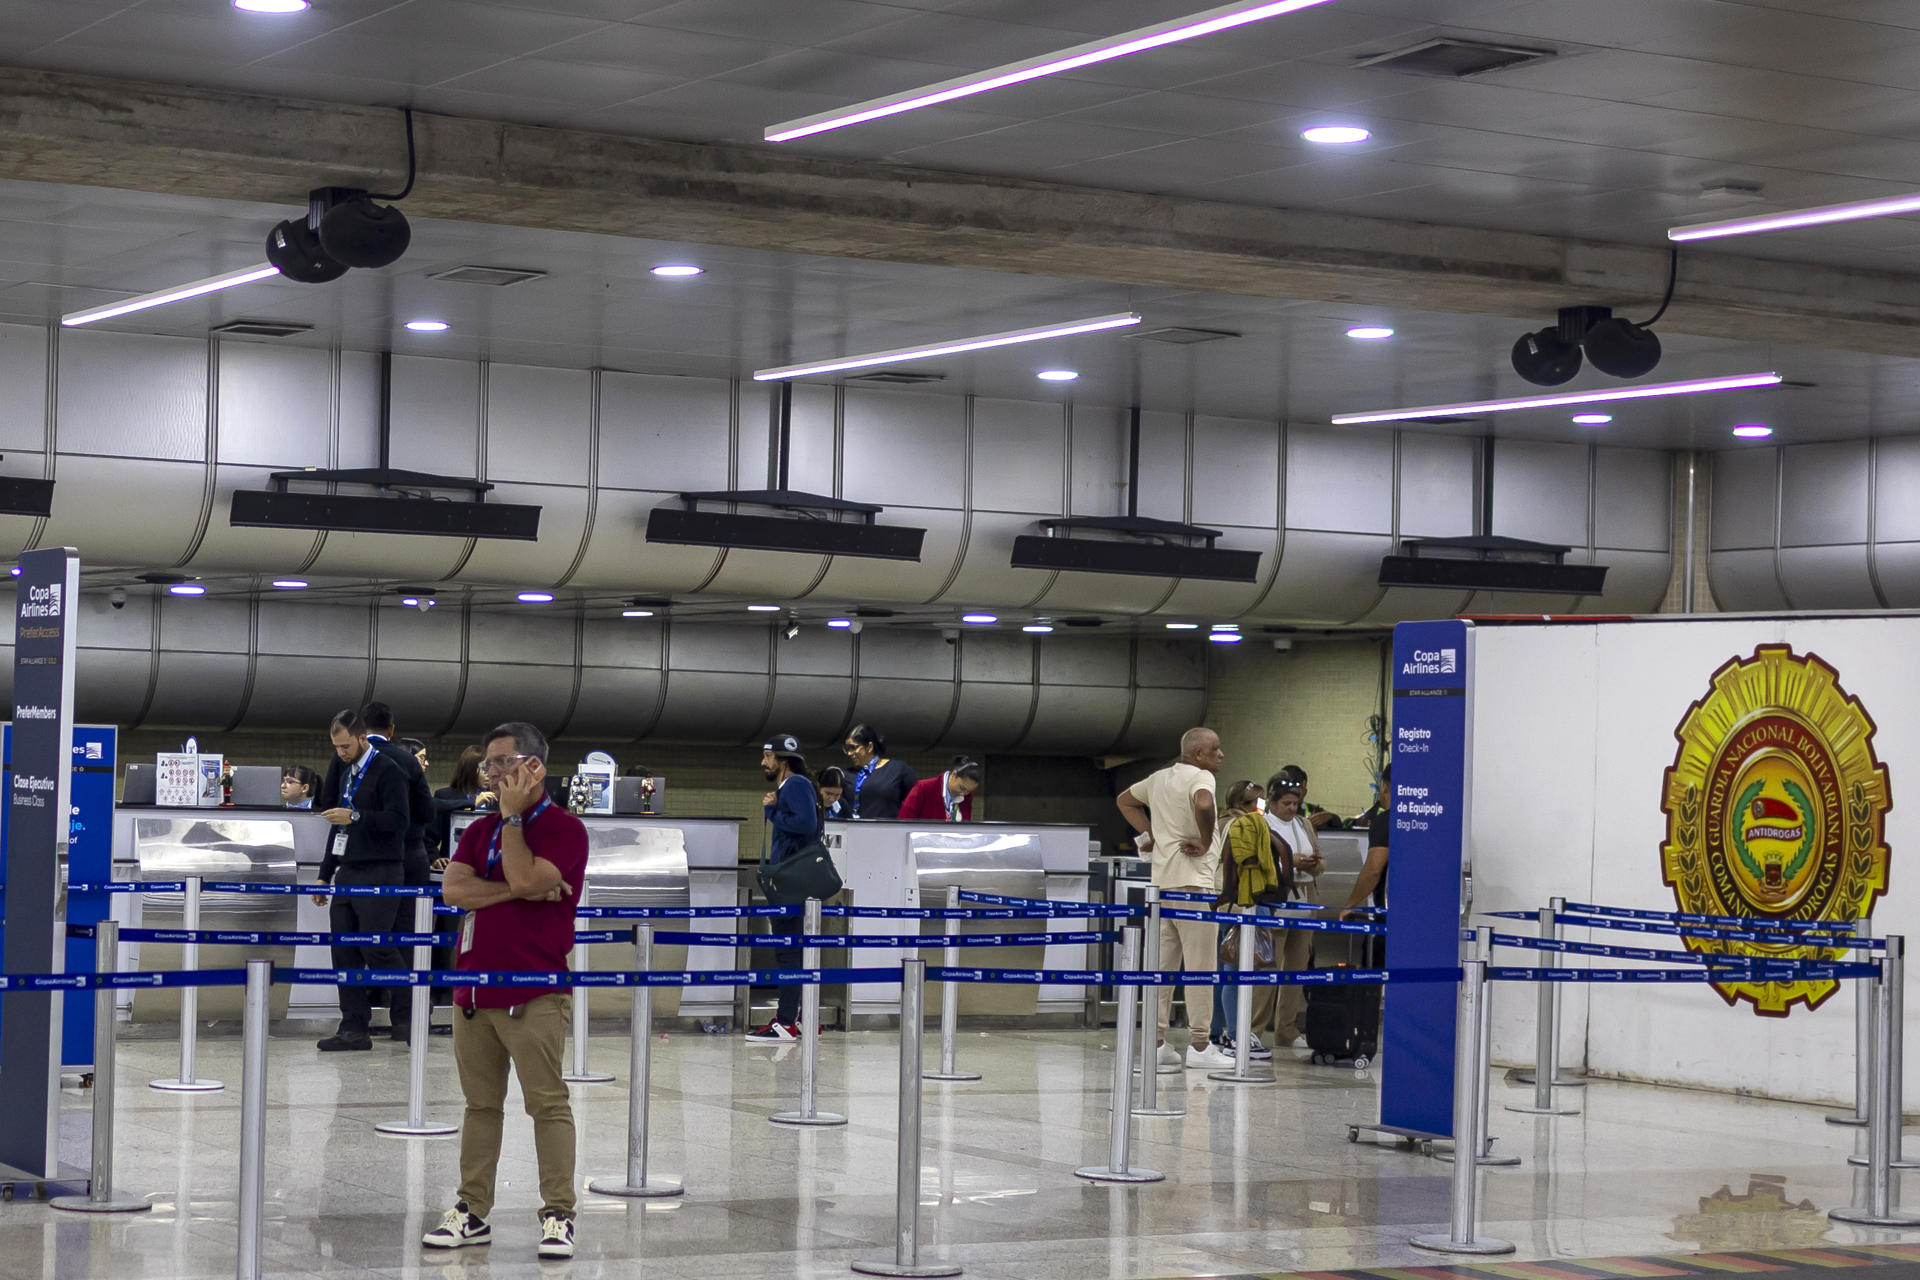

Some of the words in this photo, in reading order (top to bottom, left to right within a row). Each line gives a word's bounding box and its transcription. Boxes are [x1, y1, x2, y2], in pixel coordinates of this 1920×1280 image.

[29, 585, 49, 603] Copa
[20, 602, 49, 618] Airlines
[1413, 650, 1440, 663] Copa
[1402, 662, 1440, 674] Airlines
[16, 705, 56, 719] PreferMembers
[1398, 727, 1431, 741] Registro
[1398, 742, 1429, 753] Check-In
[13, 774, 29, 789] Clase
[29, 775, 55, 792] Ejecutiva
[1709, 769, 1732, 847] GUARDIA
[1725, 724, 1796, 768] NACIONAL
[1796, 735, 1841, 847] BOLIVARIANA
[1397, 784, 1428, 799] Entrega
[1397, 801, 1408, 813] de
[1409, 801, 1443, 816] Equipaje
[1396, 819, 1410, 832] Bag
[1411, 819, 1428, 832] Drop
[1748, 827, 1801, 840] ANTIDROGAS
